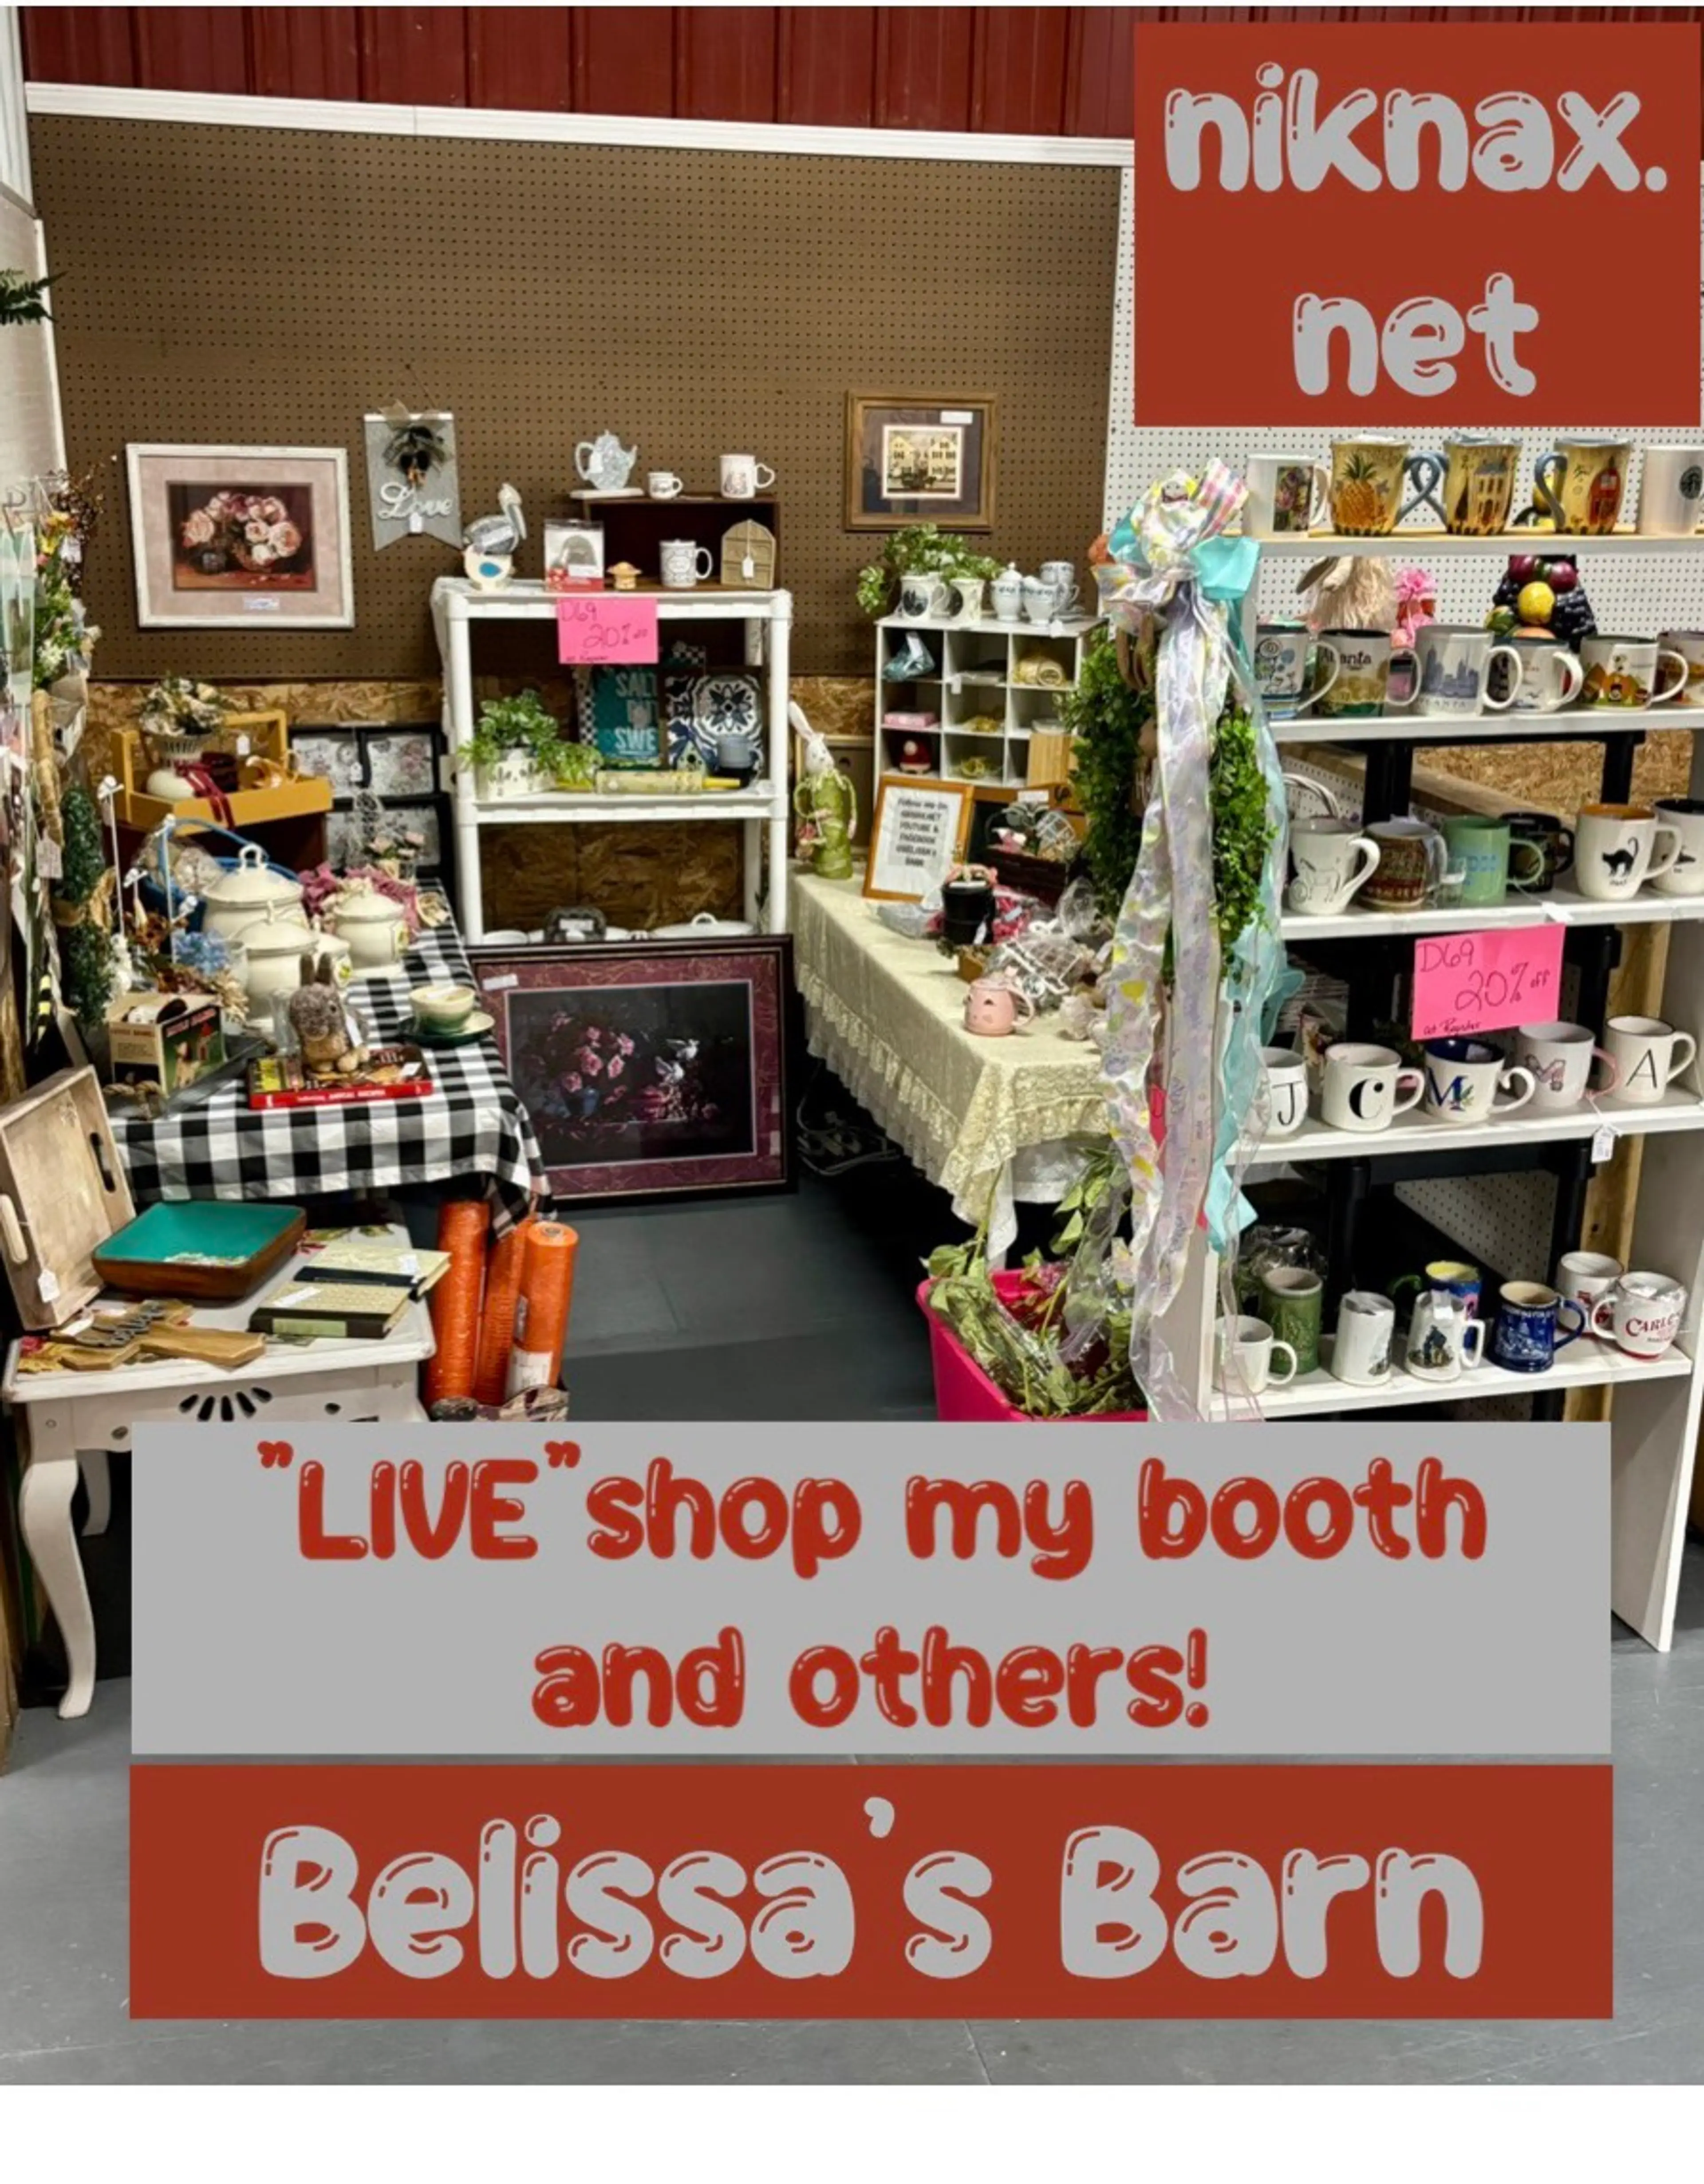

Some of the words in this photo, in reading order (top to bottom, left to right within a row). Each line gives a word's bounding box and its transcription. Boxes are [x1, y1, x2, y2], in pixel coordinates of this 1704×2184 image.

[378, 481, 453, 518] Love
[1417, 939, 1474, 972] D69
[1454, 962, 1529, 1011] 20%
[1625, 1048, 1657, 1089] A
[1349, 1077, 1384, 1120] C
[1427, 1068, 1469, 1112] M
